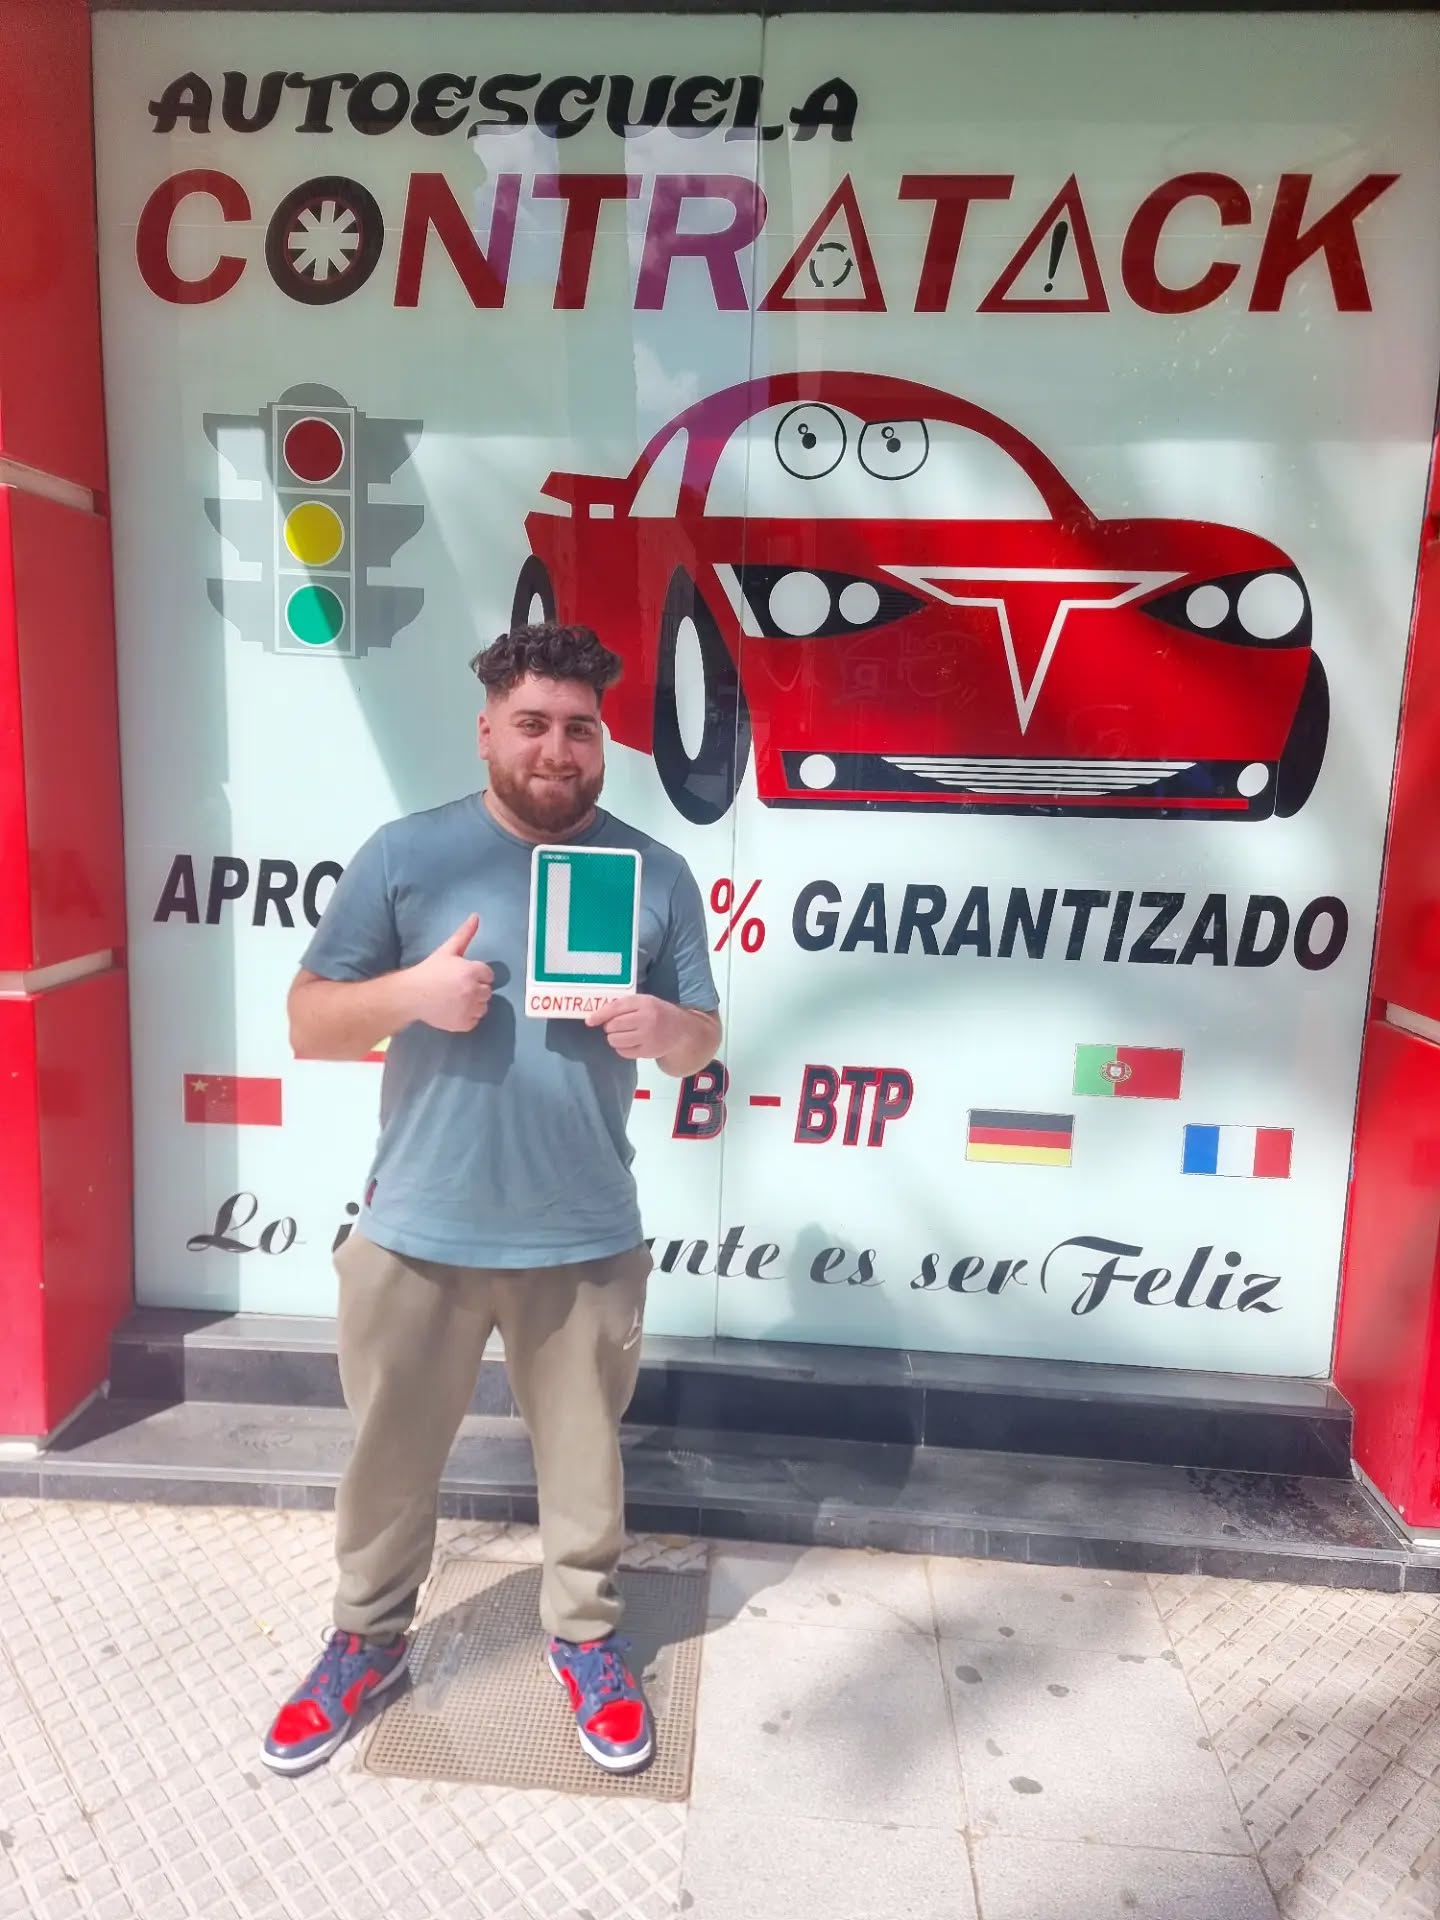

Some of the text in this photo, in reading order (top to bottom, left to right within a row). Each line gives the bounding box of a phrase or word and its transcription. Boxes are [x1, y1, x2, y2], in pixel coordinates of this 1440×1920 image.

[148, 70, 859, 142] AUTOESCUELA
[135, 168, 1402, 315] CONTRATACK
[544, 862, 623, 976] L
[791, 879, 1349, 971] GARANTIZADO
[530, 996, 618, 1012] CONTRATA
[671, 1058, 730, 1140] B
[793, 1063, 914, 1148] BTP
[186, 1191, 307, 1256] Lo
[809, 1247, 886, 1288] es
[910, 1252, 1029, 1295] ser
[1040, 1235, 1284, 1316] Feliz
